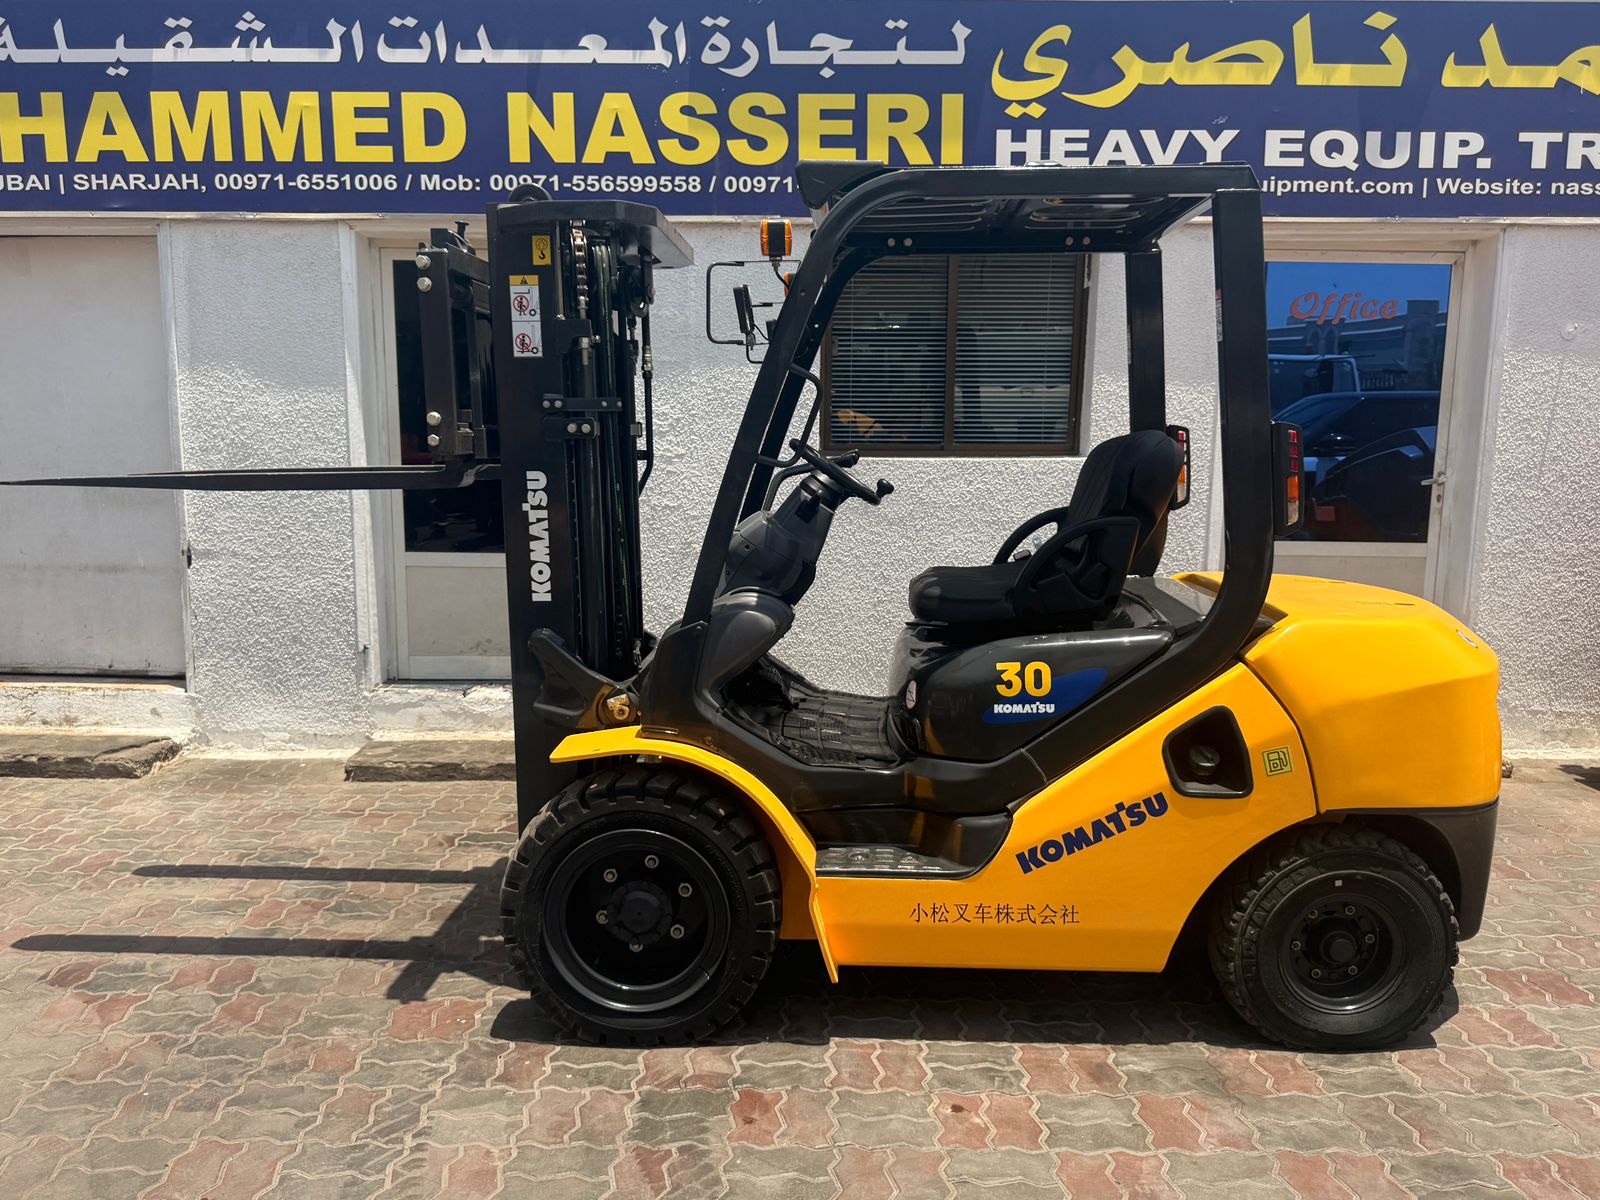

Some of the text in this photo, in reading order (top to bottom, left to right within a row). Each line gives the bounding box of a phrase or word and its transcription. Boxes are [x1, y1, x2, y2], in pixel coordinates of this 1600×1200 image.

[377, 15, 687, 69] المعدات
[701, 15, 973, 78] لتجارة
[991, 11, 1408, 119] ناصري
[0, 91, 964, 167] HAMMED NASSERI
[996, 129, 1600, 172] HEAVY EQUIP. TR
[0, 173, 51, 191] BAI
[73, 173, 207, 193] SHARJAH,
[214, 174, 398, 191] 00971-6551006
[420, 174, 481, 191] Mob:
[723, 176, 800, 193] 00971
[1436, 177, 1542, 195] Website:
[1290, 291, 1400, 325] Office
[522, 470, 552, 602] KOMATSU
[995, 661, 1052, 697] 30
[993, 701, 1055, 714] KOMATSU
[1015, 791, 1169, 875] KOMATSU
[909, 902, 1080, 925] 小松叉车株式会社
